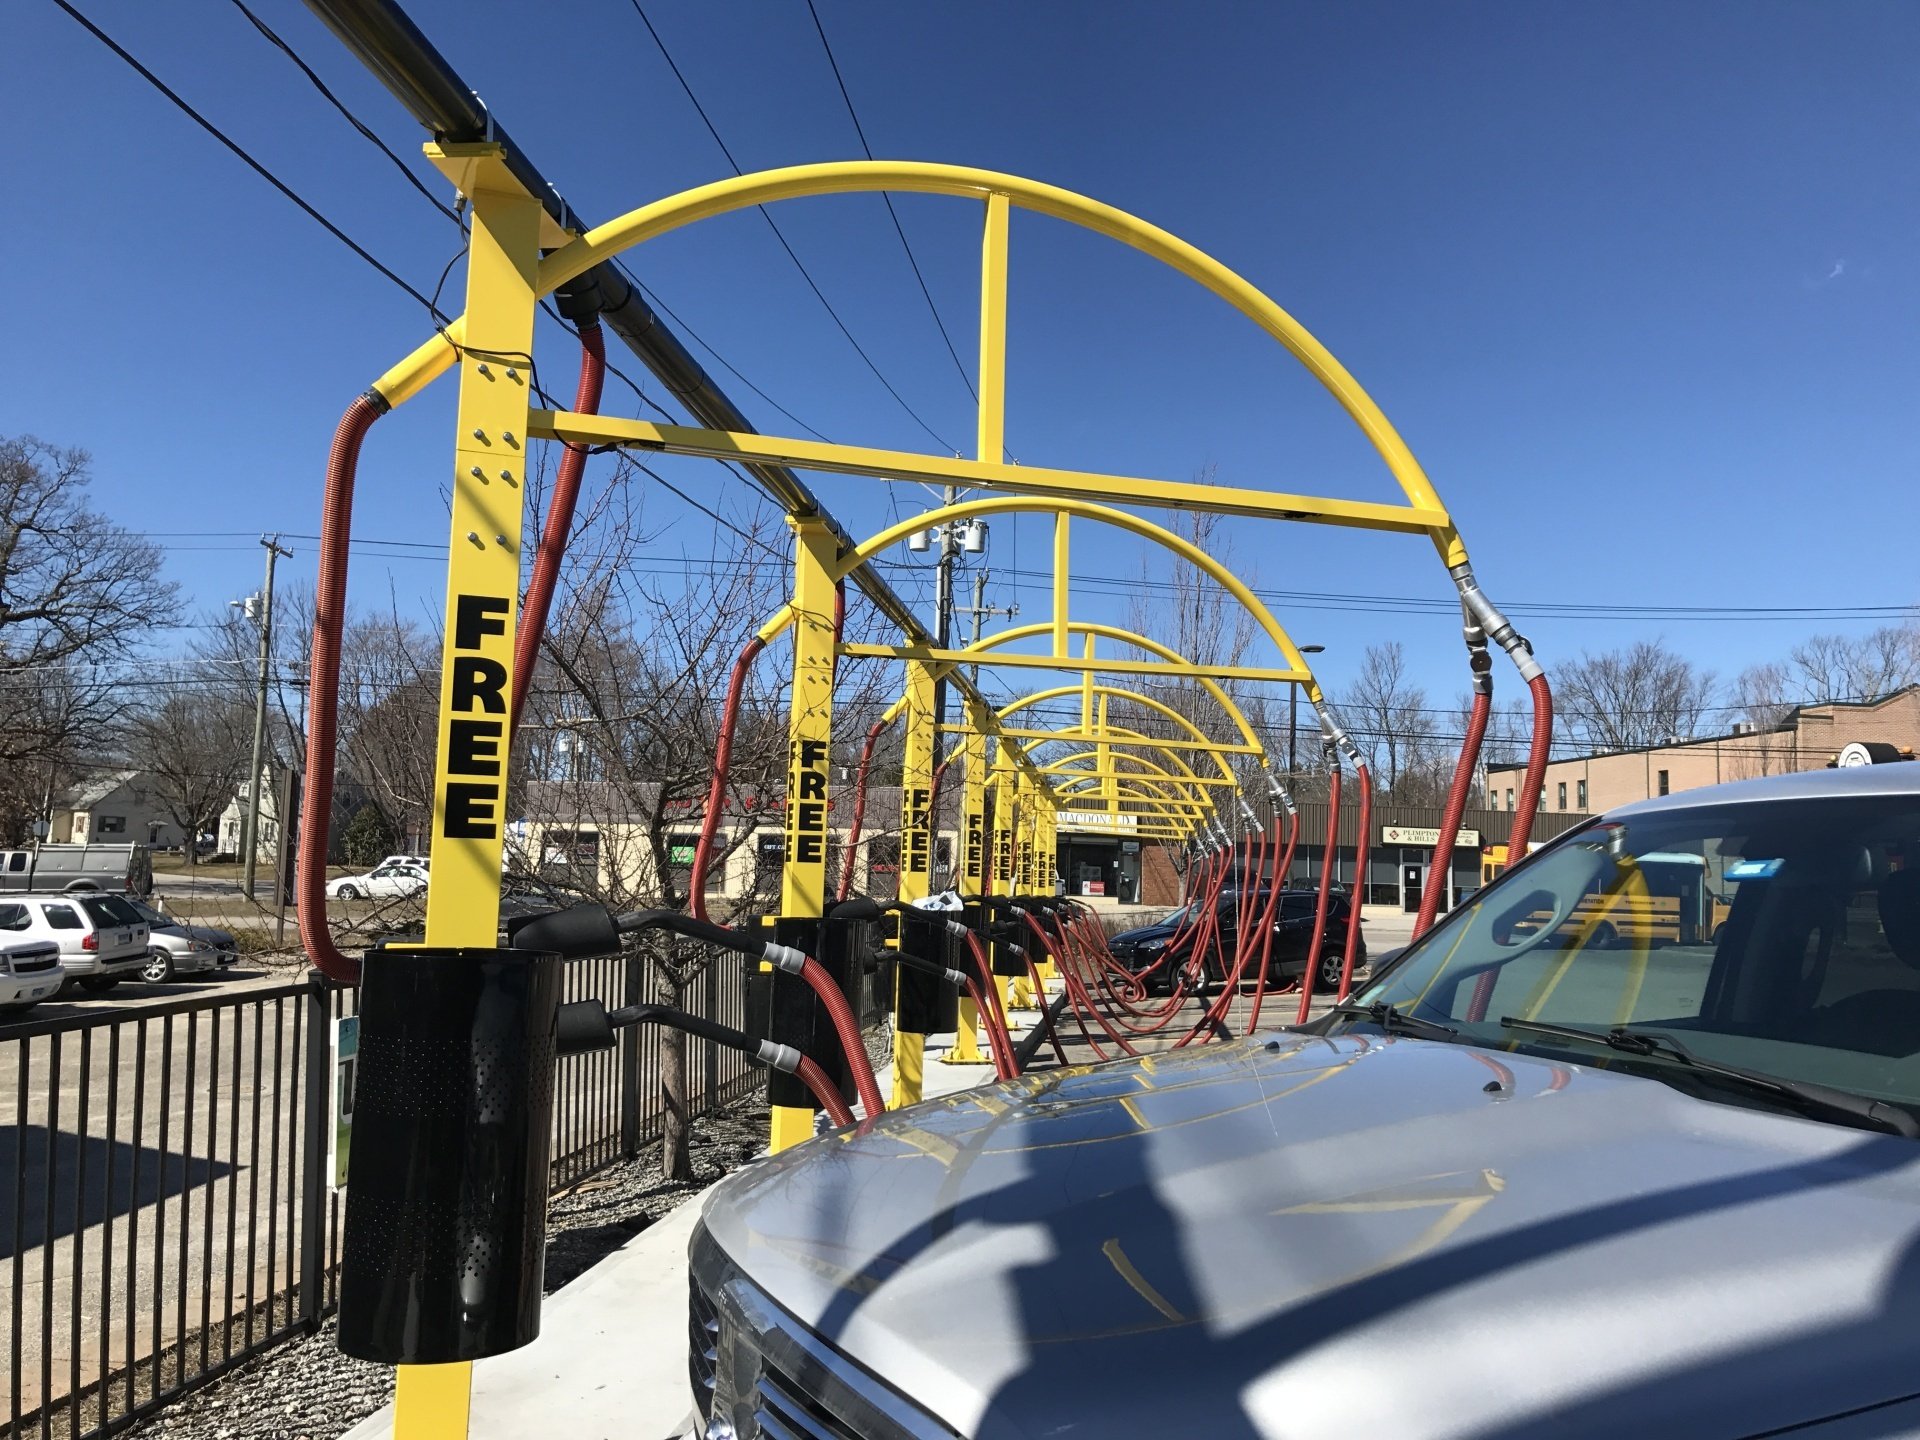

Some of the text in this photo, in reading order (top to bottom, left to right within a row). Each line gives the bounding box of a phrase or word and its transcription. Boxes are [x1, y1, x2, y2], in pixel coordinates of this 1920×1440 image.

[444, 594, 510, 839] FREE
[785, 741, 797, 862] FREE
[797, 740, 827, 863] FREE
[910, 789, 931, 872] FREE
[1059, 812, 1130, 825] MACDONAD
[968, 814, 982, 878] FREE
[1000, 829, 1011, 881] FREE
[1403, 829, 1439, 837] PLIMPTON
[1022, 842, 1031, 885] FREE
[1038, 851, 1046, 888] FREE
